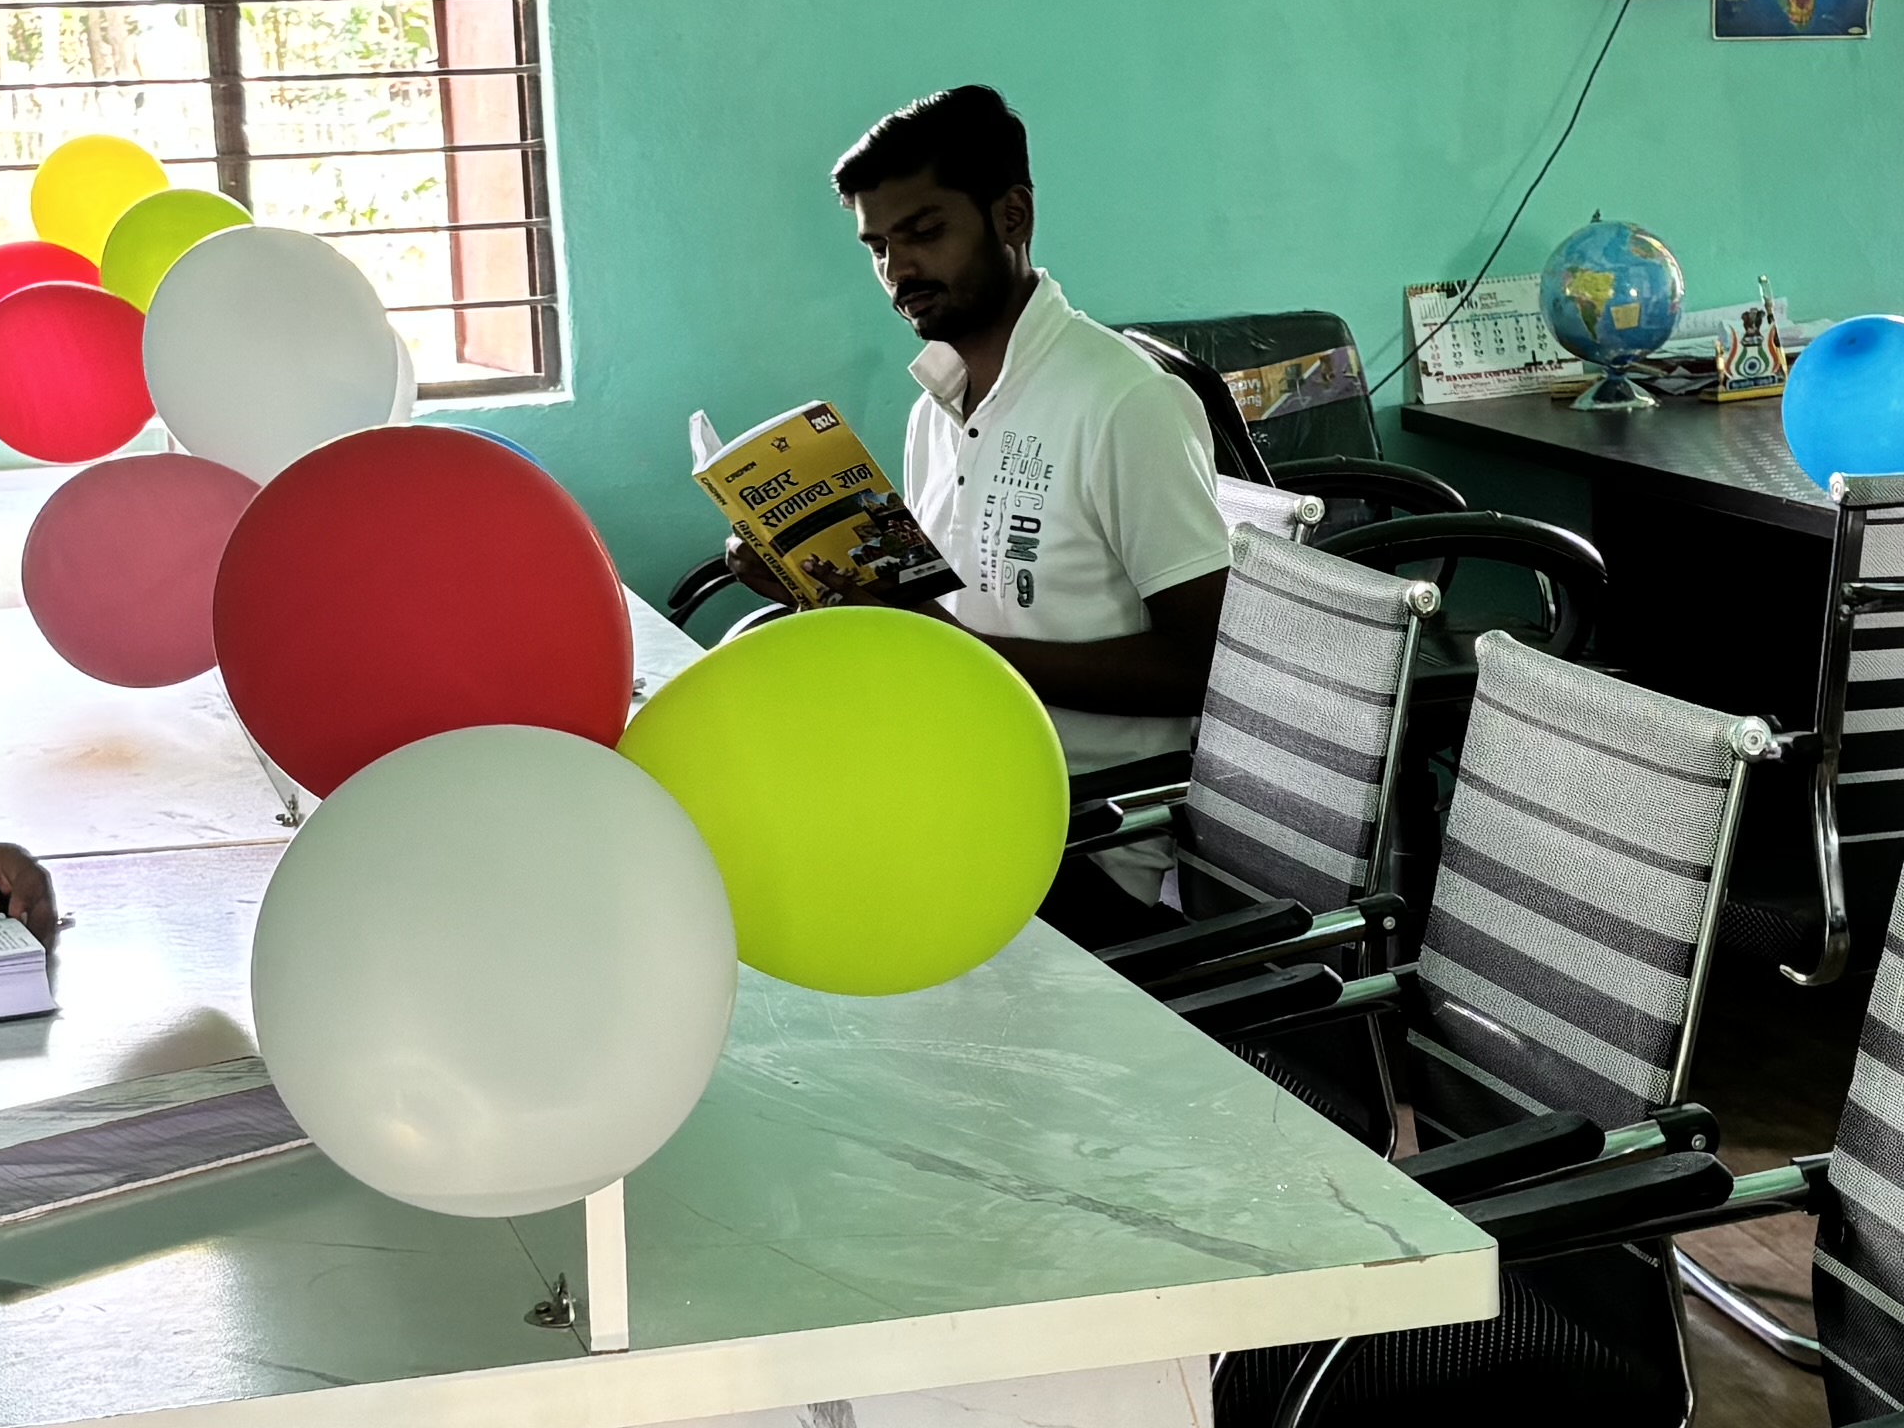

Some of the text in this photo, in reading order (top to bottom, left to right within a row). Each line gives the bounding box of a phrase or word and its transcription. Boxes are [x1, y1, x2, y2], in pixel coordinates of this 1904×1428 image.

[811, 413, 837, 431] 2024
[724, 461, 757, 484] CROWN
[700, 477, 728, 506] CROWN
[739, 468, 799, 511] बिहार
[758, 463, 874, 529] सामान्य ज्ञान
